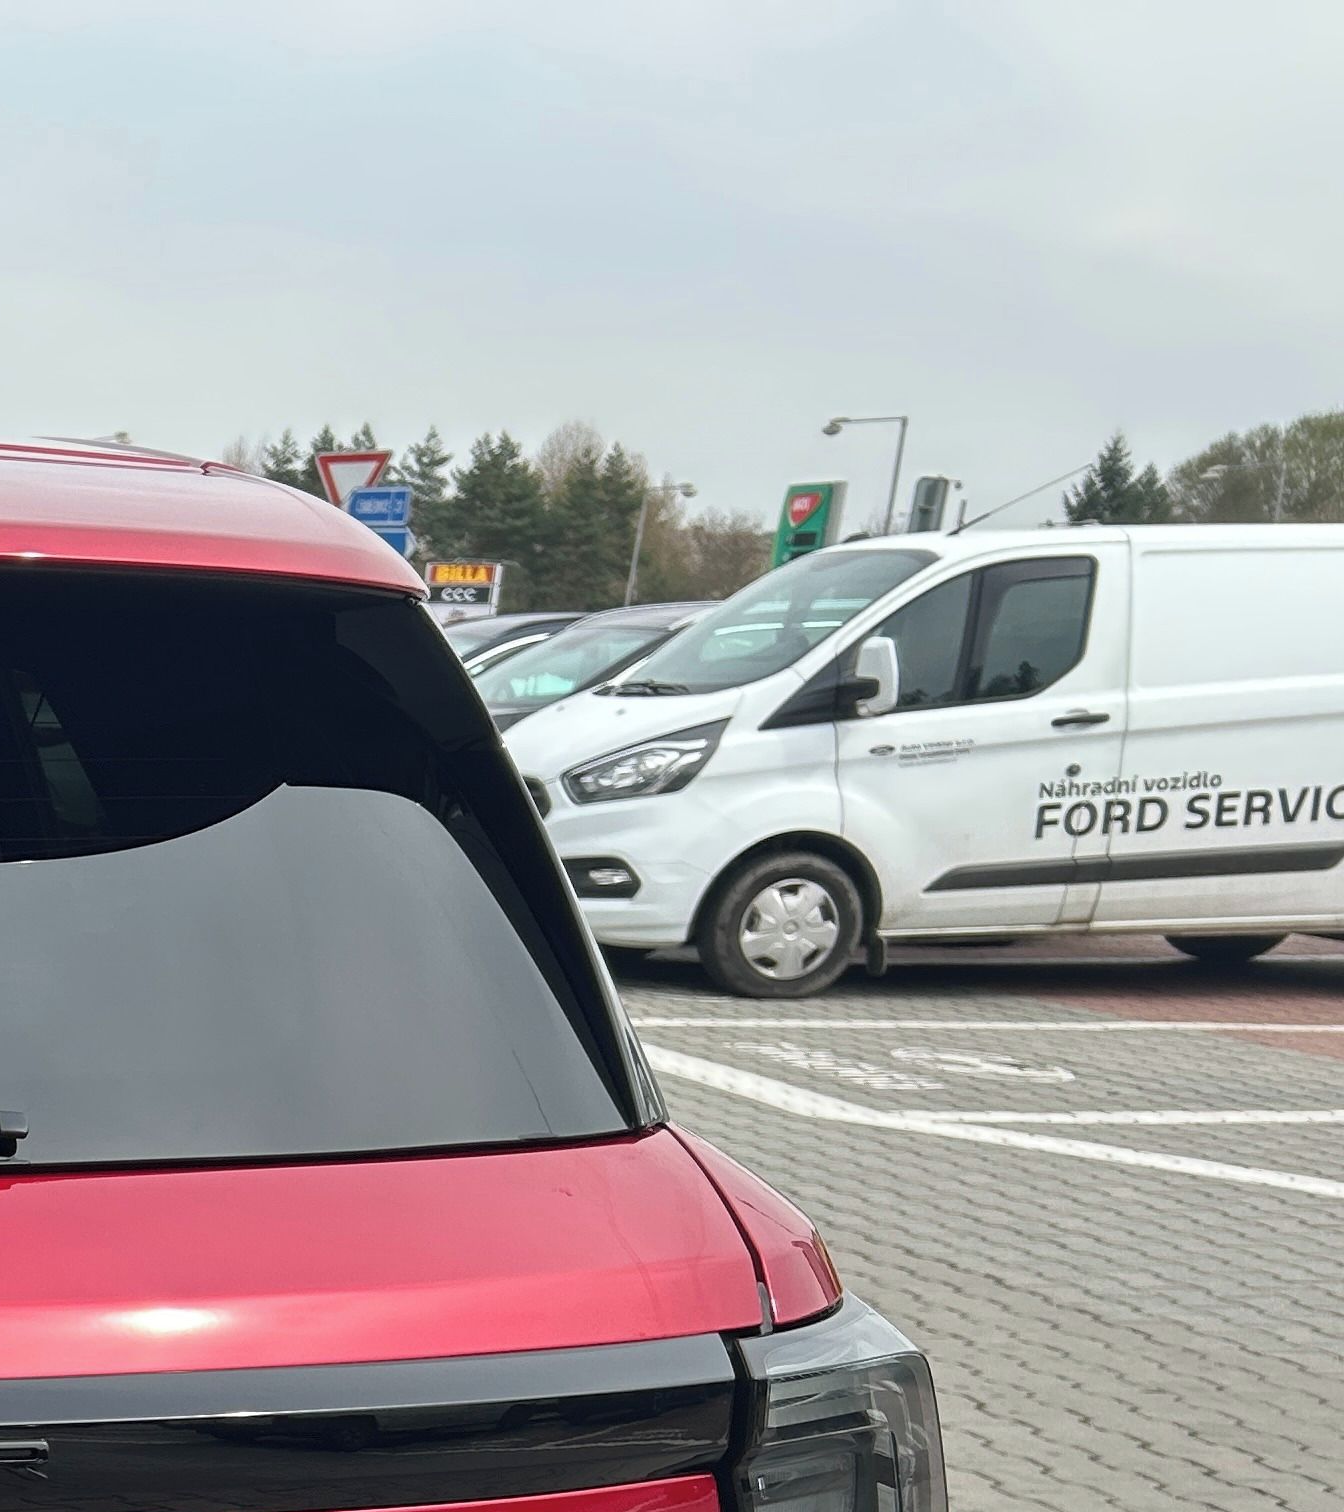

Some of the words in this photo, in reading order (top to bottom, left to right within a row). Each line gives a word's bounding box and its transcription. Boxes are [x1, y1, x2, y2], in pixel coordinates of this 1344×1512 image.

[1038, 774, 1139, 799] Náhradní
[1143, 771, 1222, 793] vozidlo
[1034, 797, 1169, 840] FORD
